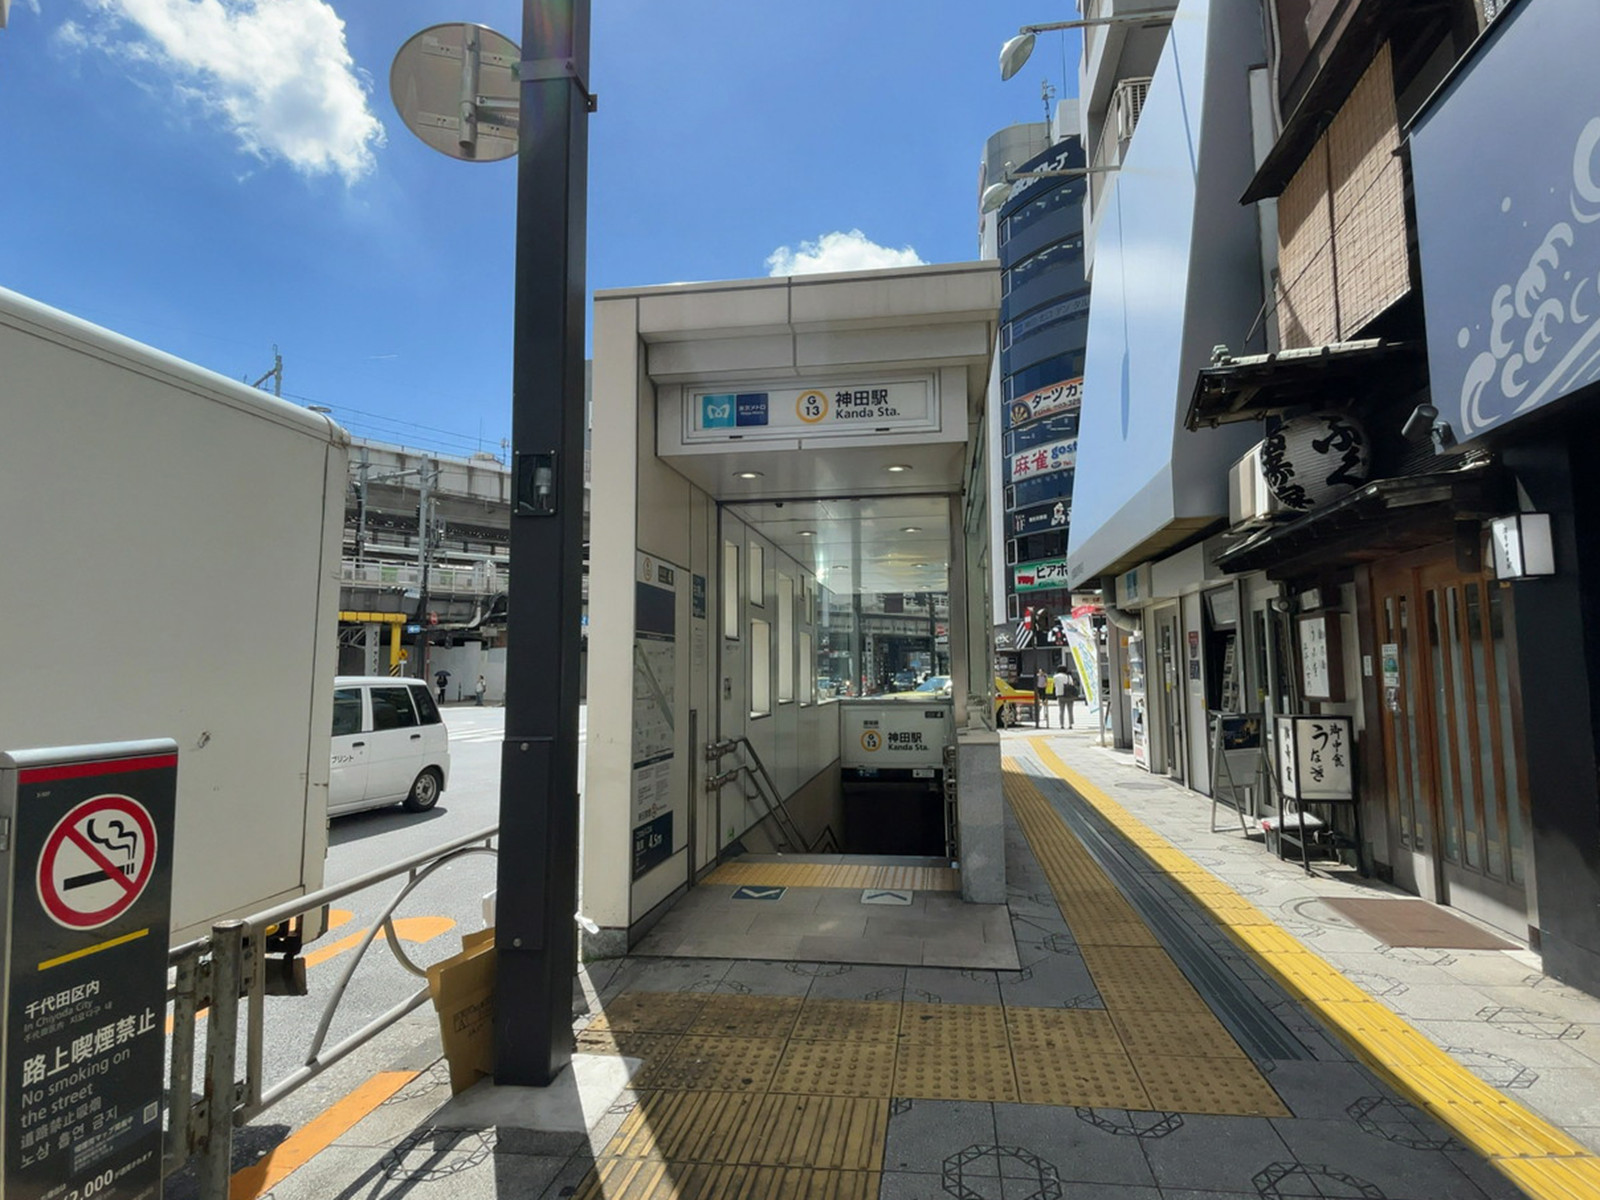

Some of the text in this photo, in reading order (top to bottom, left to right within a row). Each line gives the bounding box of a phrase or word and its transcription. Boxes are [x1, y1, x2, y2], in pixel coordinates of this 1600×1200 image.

[805, 405, 820, 416] 13
[807, 396, 817, 405] G
[835, 389, 889, 407] 神田駅
[836, 405, 901, 419] Kanda Sta.
[1013, 450, 1048, 476] 麻雀
[888, 732, 922, 743] 神田駅
[1310, 724, 1328, 782] うなぎ
[25, 980, 100, 1019] 千代田区内
[36, 1007, 73, 1027] Chiyoda
[76, 1000, 93, 1011] City
[22, 1007, 155, 1088] 路上喫煙禁止
[22, 1048, 130, 1109] No smoking on
[20, 1083, 93, 1128] the street
[20, 1141, 50, 1169] 노상
[92, 1105, 117, 1130] 금지
